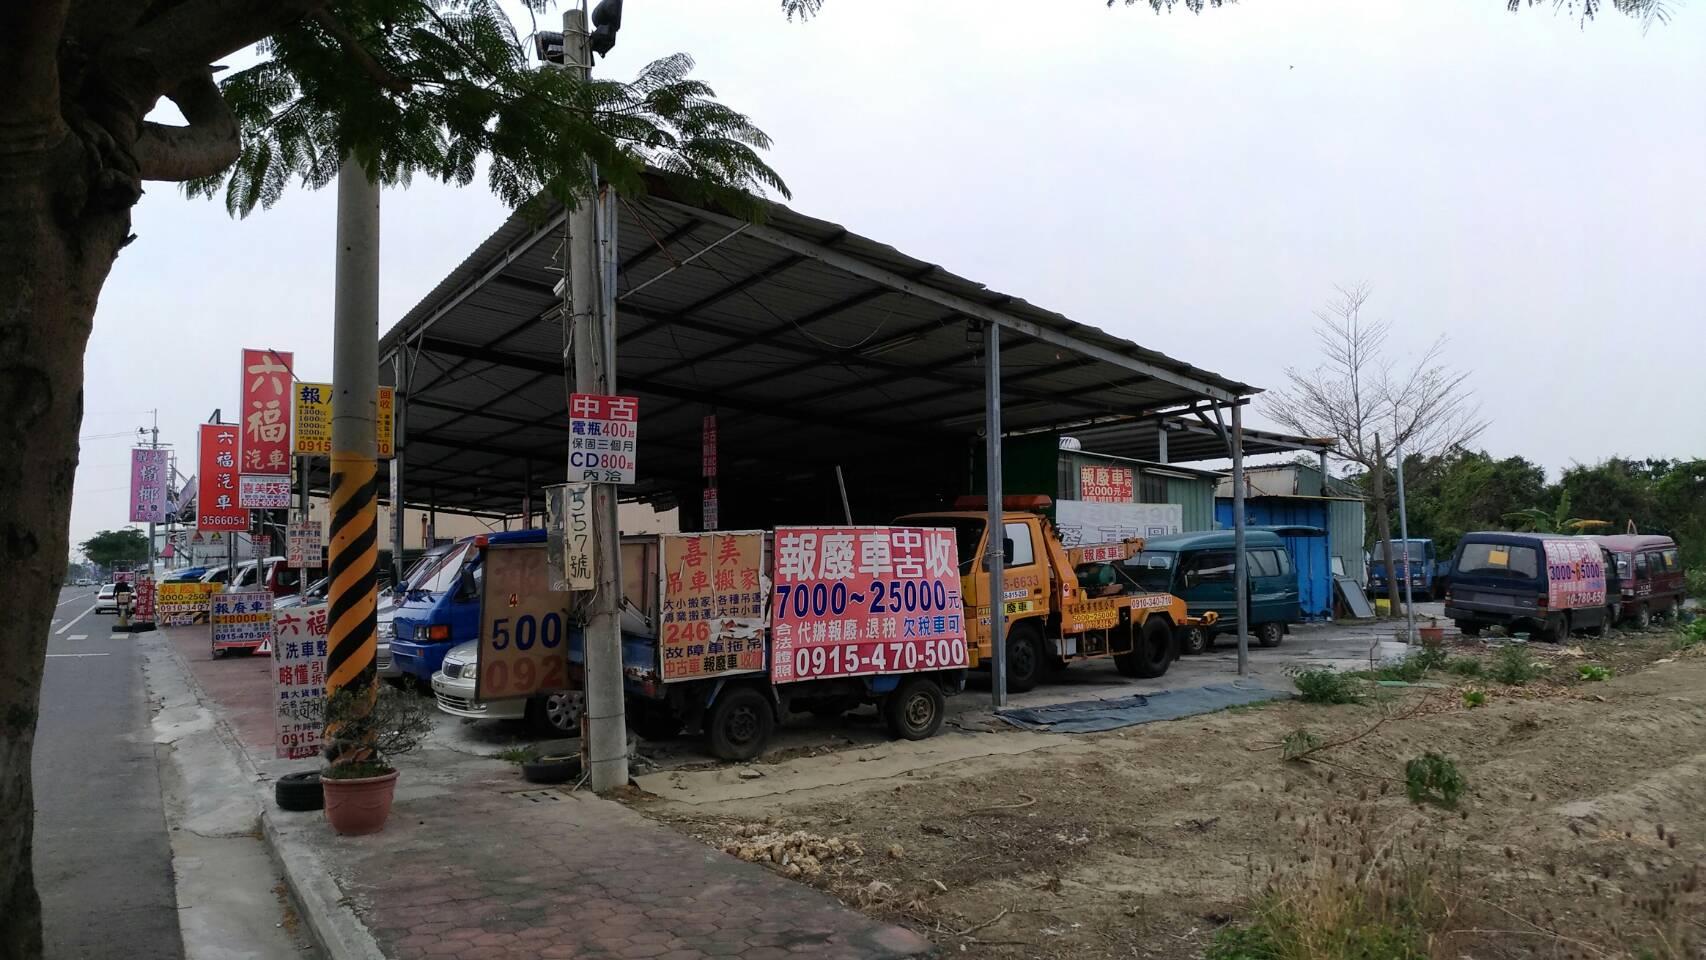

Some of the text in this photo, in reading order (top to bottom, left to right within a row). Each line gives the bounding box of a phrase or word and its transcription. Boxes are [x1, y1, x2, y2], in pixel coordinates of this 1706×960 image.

[247, 355, 289, 443] 六福
[300, 386, 333, 405] 報
[380, 390, 391, 409] 回收
[573, 396, 636, 420] 中古
[298, 440, 332, 452] 0915
[572, 438, 634, 452] 保固三個月
[216, 431, 235, 510] 六福汽車
[245, 449, 287, 470] 汽車
[583, 470, 622, 482] 內洽
[1082, 467, 1124, 487] 報廢車
[202, 515, 245, 526] 3566054
[682, 537, 741, 568] 喜美
[1084, 547, 1117, 561] 報廢車
[667, 568, 761, 596] 吊車搬家
[215, 601, 265, 614] 報廢車
[664, 597, 711, 611] 大小搬家
[1006, 602, 1028, 614] 廢車
[277, 610, 328, 636] 六福
[492, 612, 562, 651] 500
[667, 621, 710, 644] 246
[903, 615, 960, 638] 欠稅車可
[286, 640, 328, 659] 洗車整
[666, 638, 762, 660] 故障車拖吊
[775, 623, 793, 678] 合法證照
[796, 639, 965, 677] 0915-470-500
[485, 655, 563, 695] 092
[665, 656, 700, 677] 中古車
[703, 653, 737, 673] 報廢車
